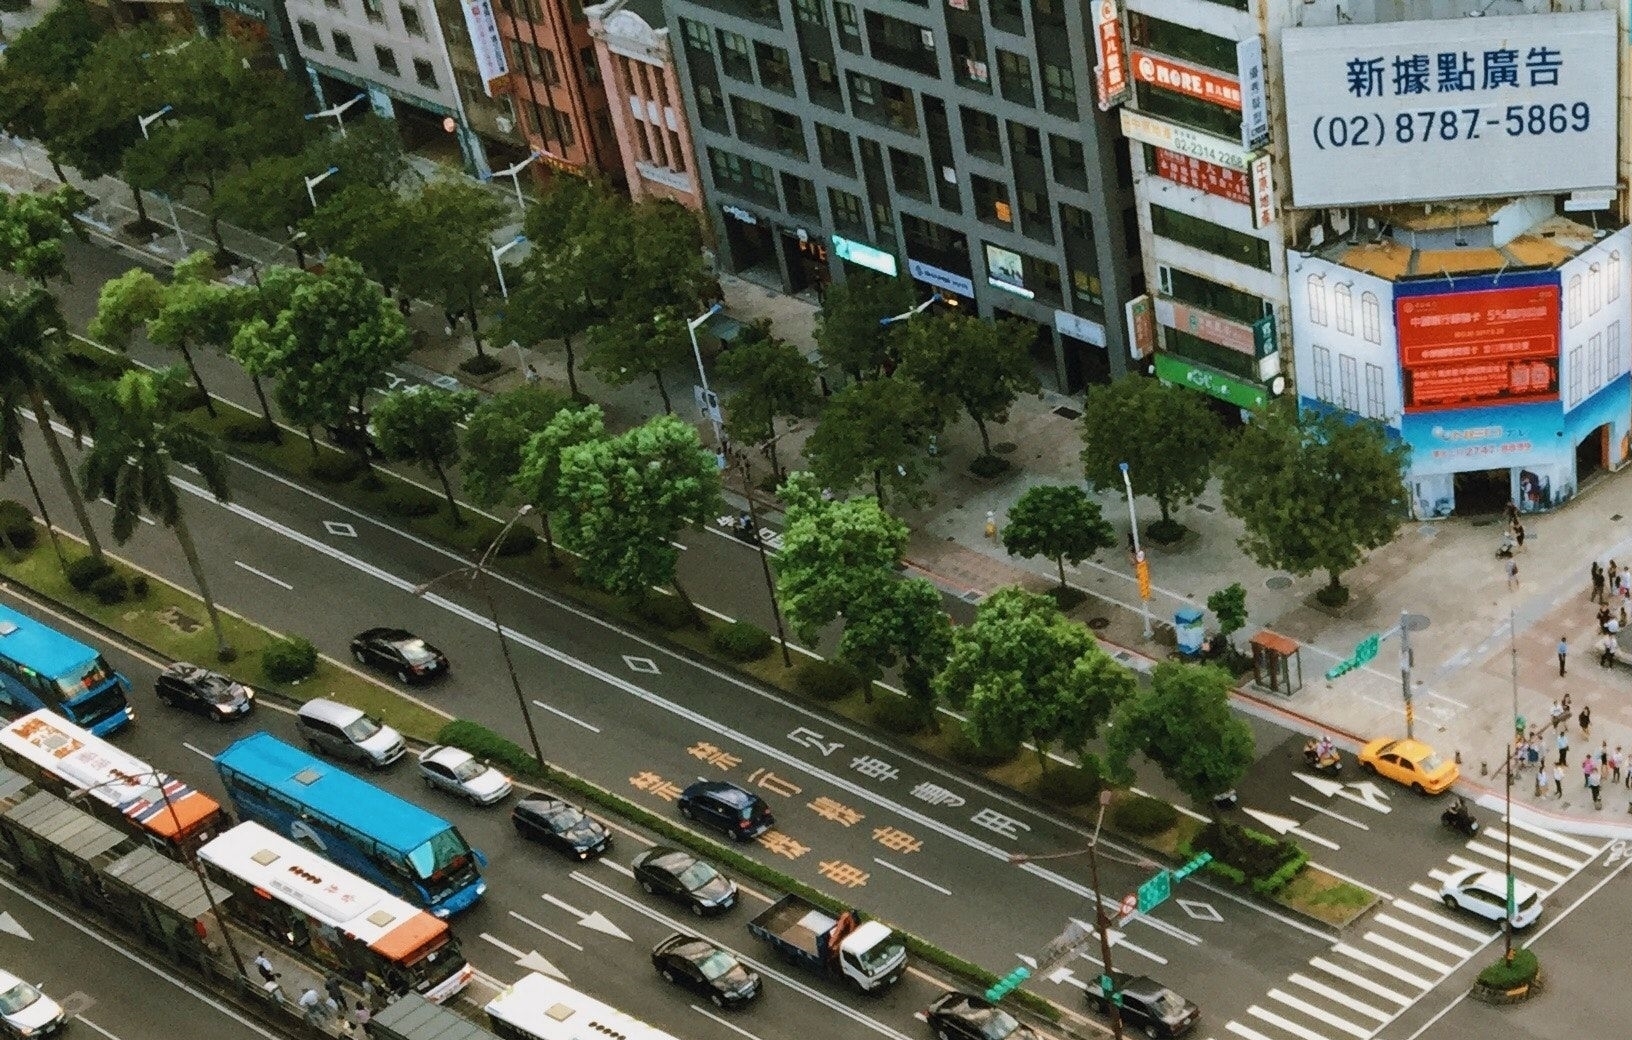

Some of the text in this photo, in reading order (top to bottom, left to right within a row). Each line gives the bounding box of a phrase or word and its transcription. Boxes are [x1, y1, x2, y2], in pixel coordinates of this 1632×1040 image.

[1346, 46, 1564, 98] 新據點廣告
[1313, 101, 1590, 150] (02)8787-5869
